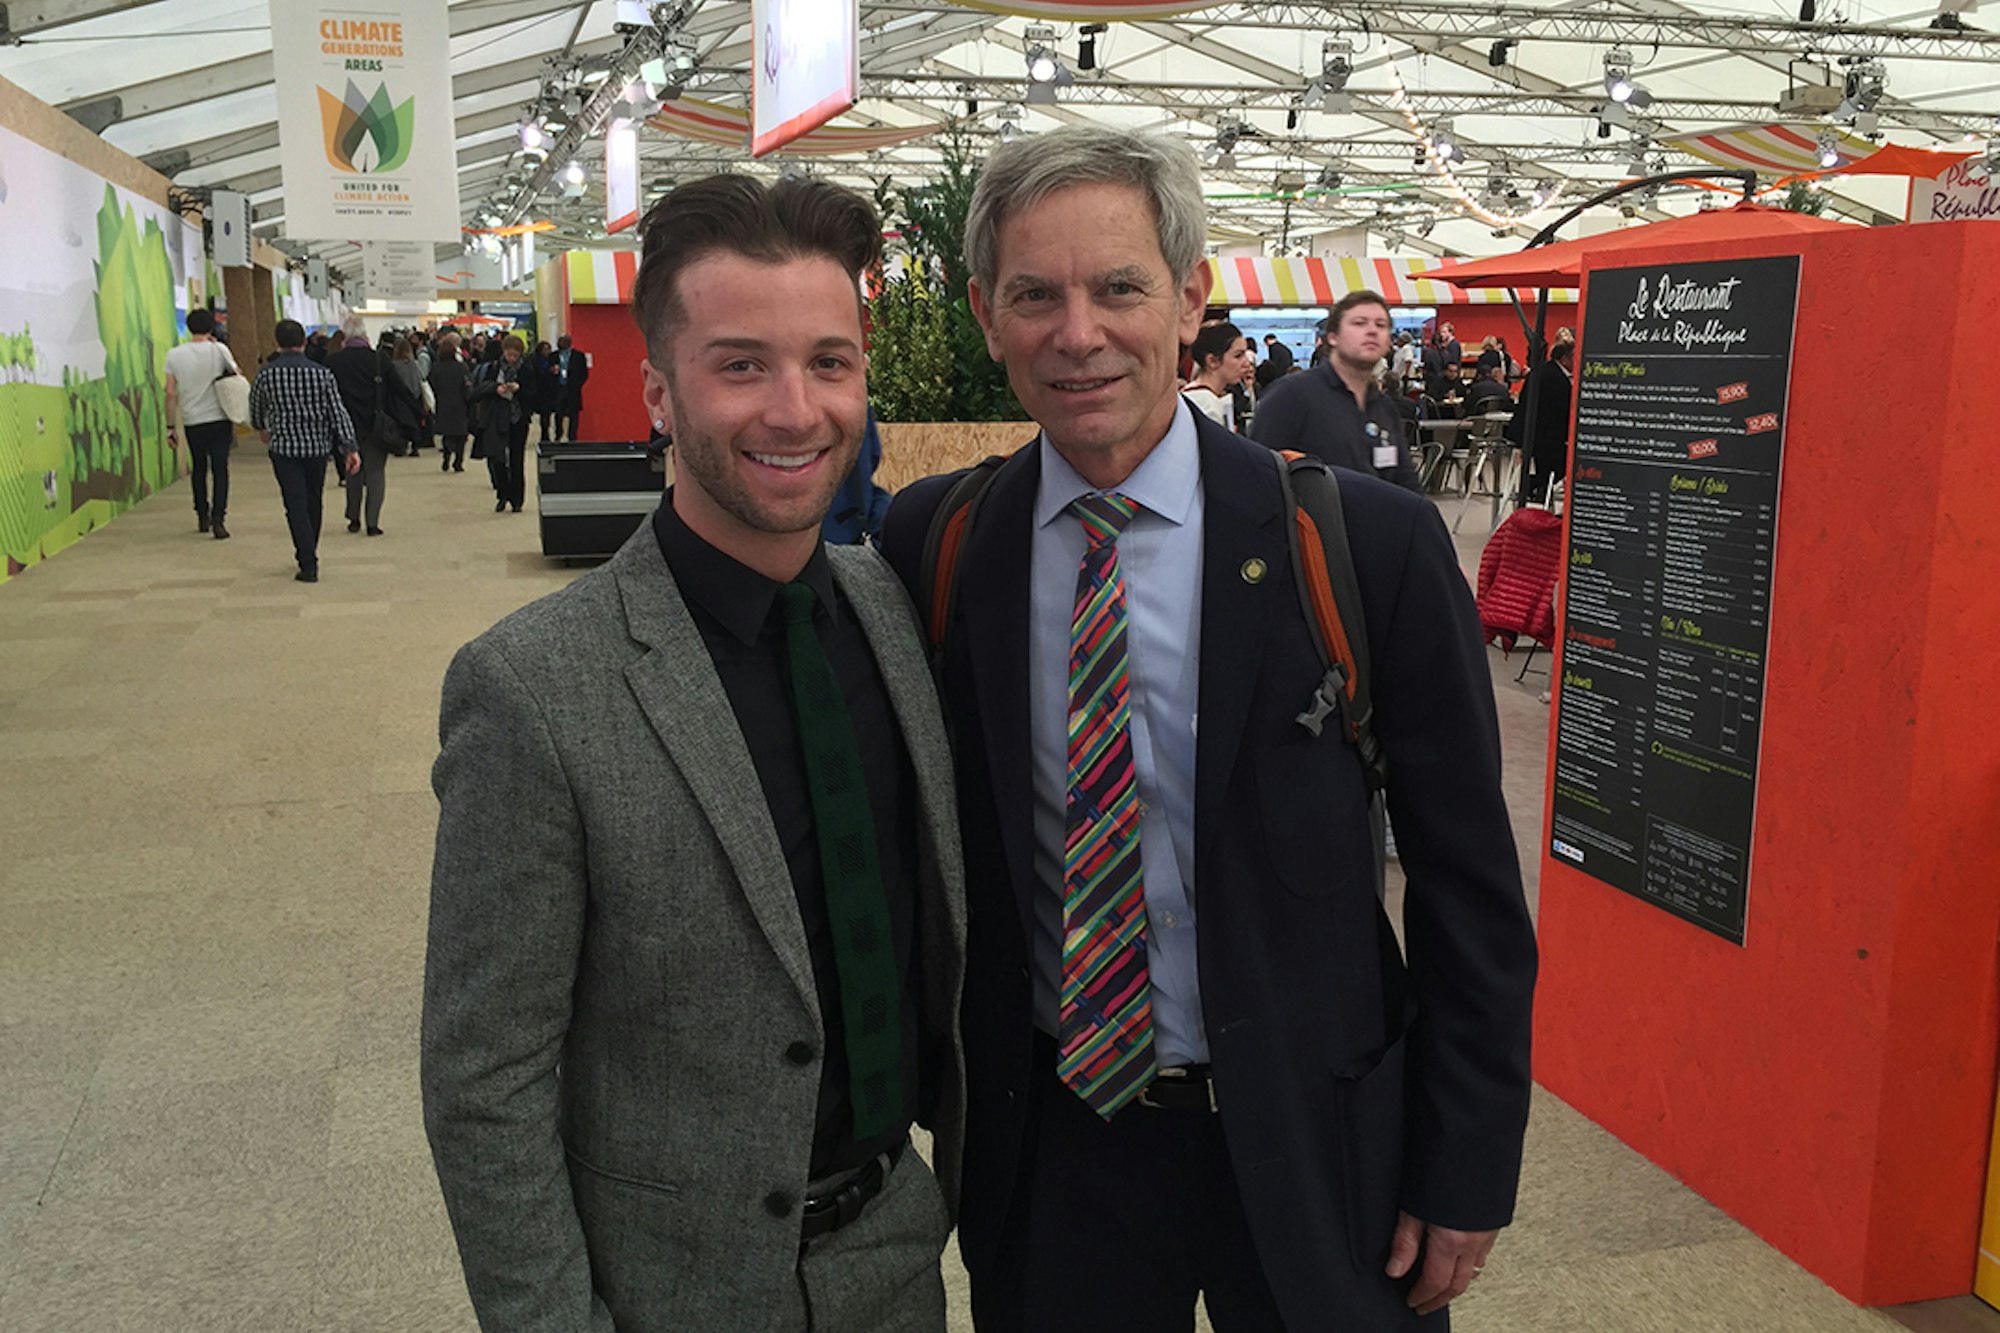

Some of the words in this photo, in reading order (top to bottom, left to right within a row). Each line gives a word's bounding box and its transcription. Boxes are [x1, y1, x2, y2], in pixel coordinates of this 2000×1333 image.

[320, 19, 402, 43] CLIMATE
[321, 42, 404, 57] GENERATIONS
[344, 58, 383, 72] AREAS
[343, 183, 377, 191] UNITED
[382, 183, 399, 192] FOR
[334, 192, 372, 201] CLIMATE
[377, 193, 410, 202] ACTION
[1628, 276, 1649, 319] Le
[1652, 273, 1743, 319] Restaurant
[1618, 320, 1649, 344] Place
[1650, 328, 1660, 341] de
[1661, 327, 1671, 341] la
[1673, 319, 1747, 353] République
